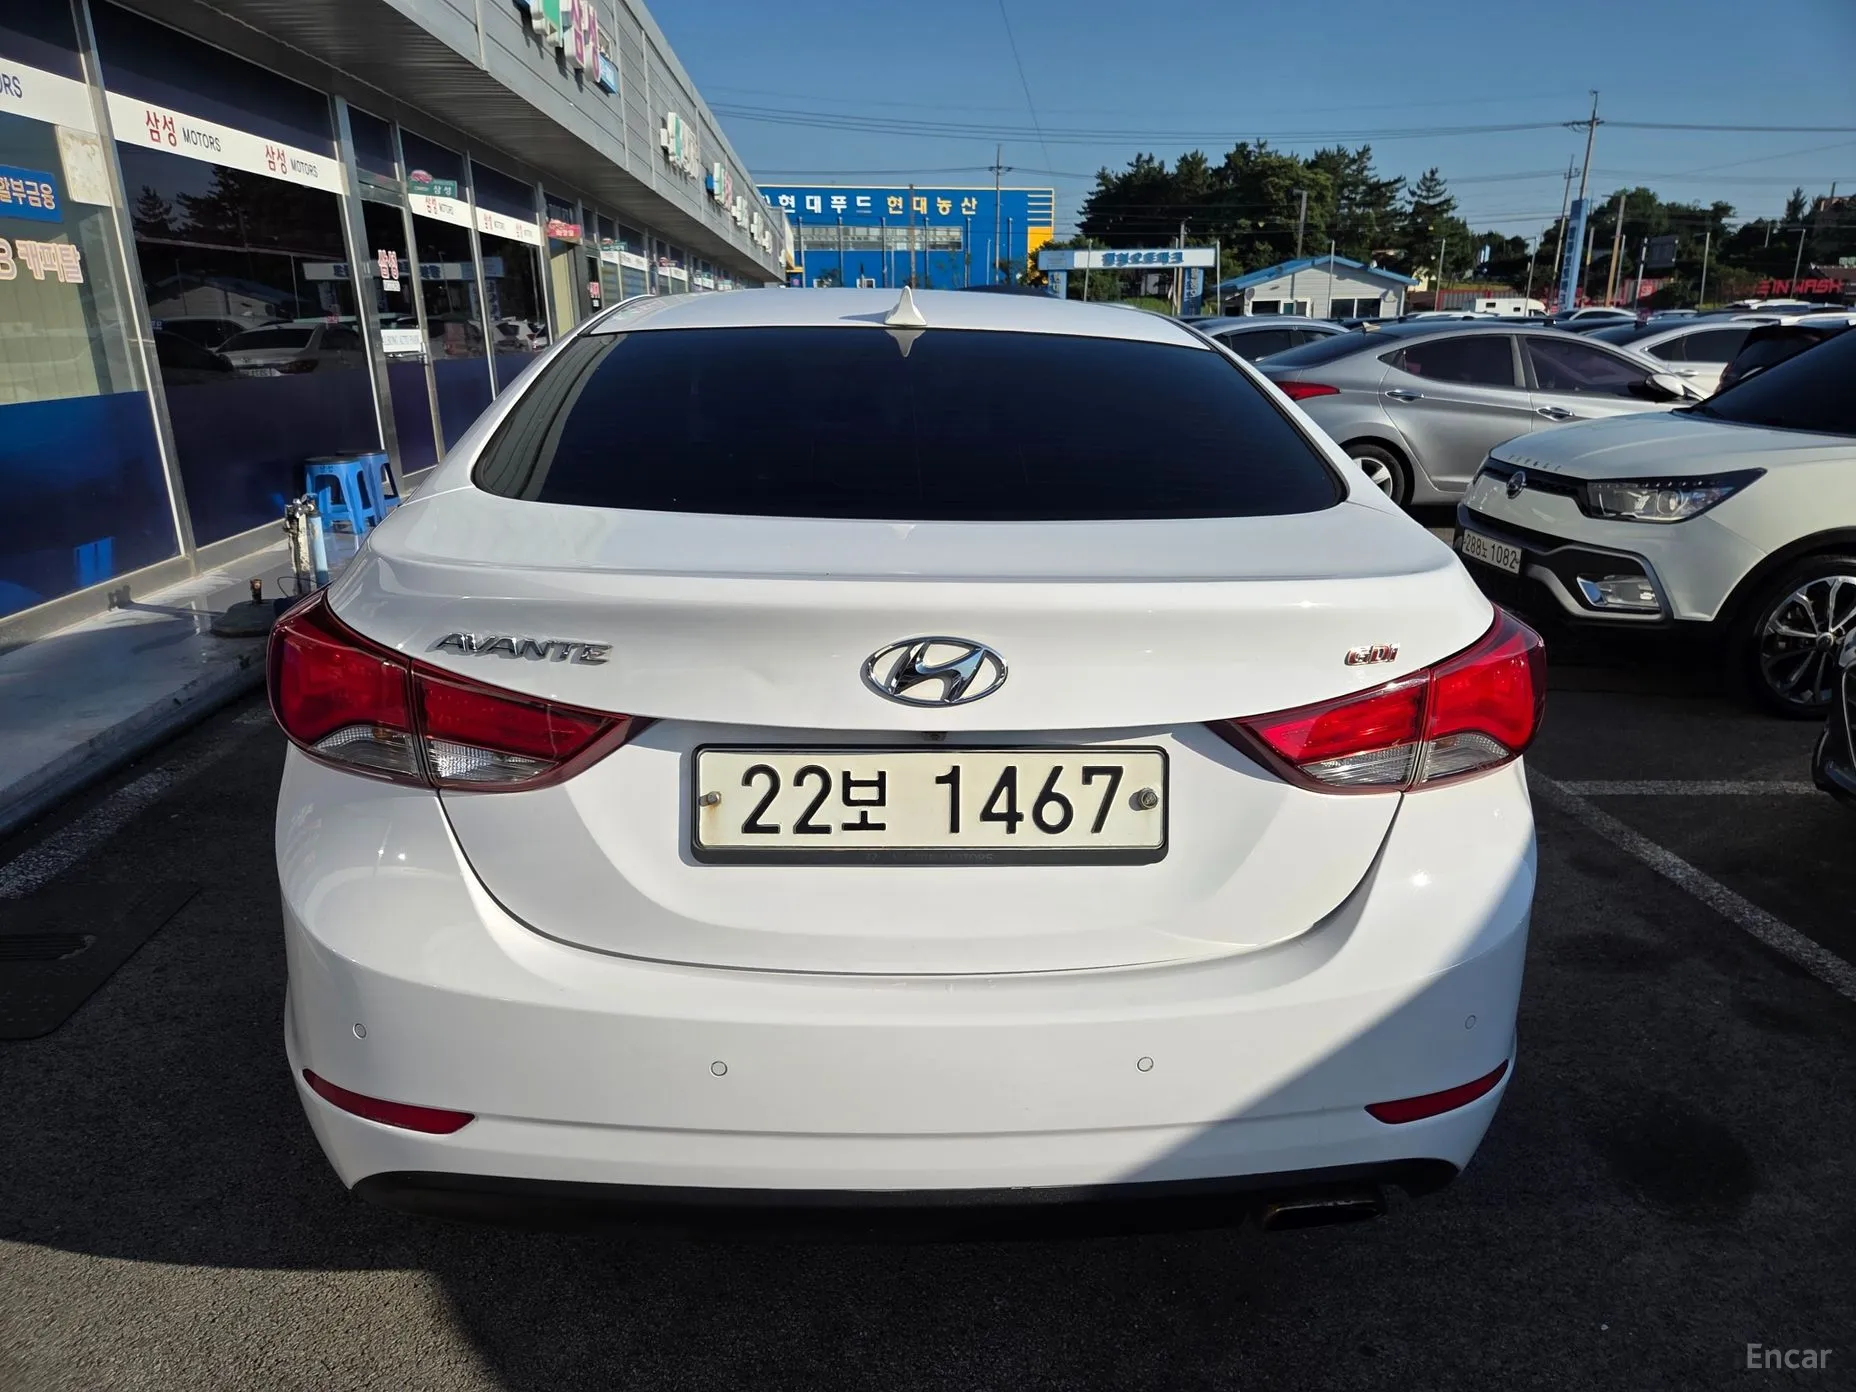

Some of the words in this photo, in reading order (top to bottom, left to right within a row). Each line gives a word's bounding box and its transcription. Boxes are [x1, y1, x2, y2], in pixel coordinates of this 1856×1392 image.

[0, 73, 22, 98] RS
[146, 110, 177, 147] 삼성
[182, 127, 222, 152] MOTORS
[265, 144, 288, 175] 삼성
[290, 159, 319, 178] MOTORS
[778, 195, 871, 214] 현대푸드
[886, 195, 977, 216] 현대농산
[1465, 533, 1488, 558] 288노
[1491, 543, 1519, 569] 1082
[430, 632, 614, 665] AVANTE
[741, 763, 887, 835] 22보
[934, 763, 1125, 835] 1467
